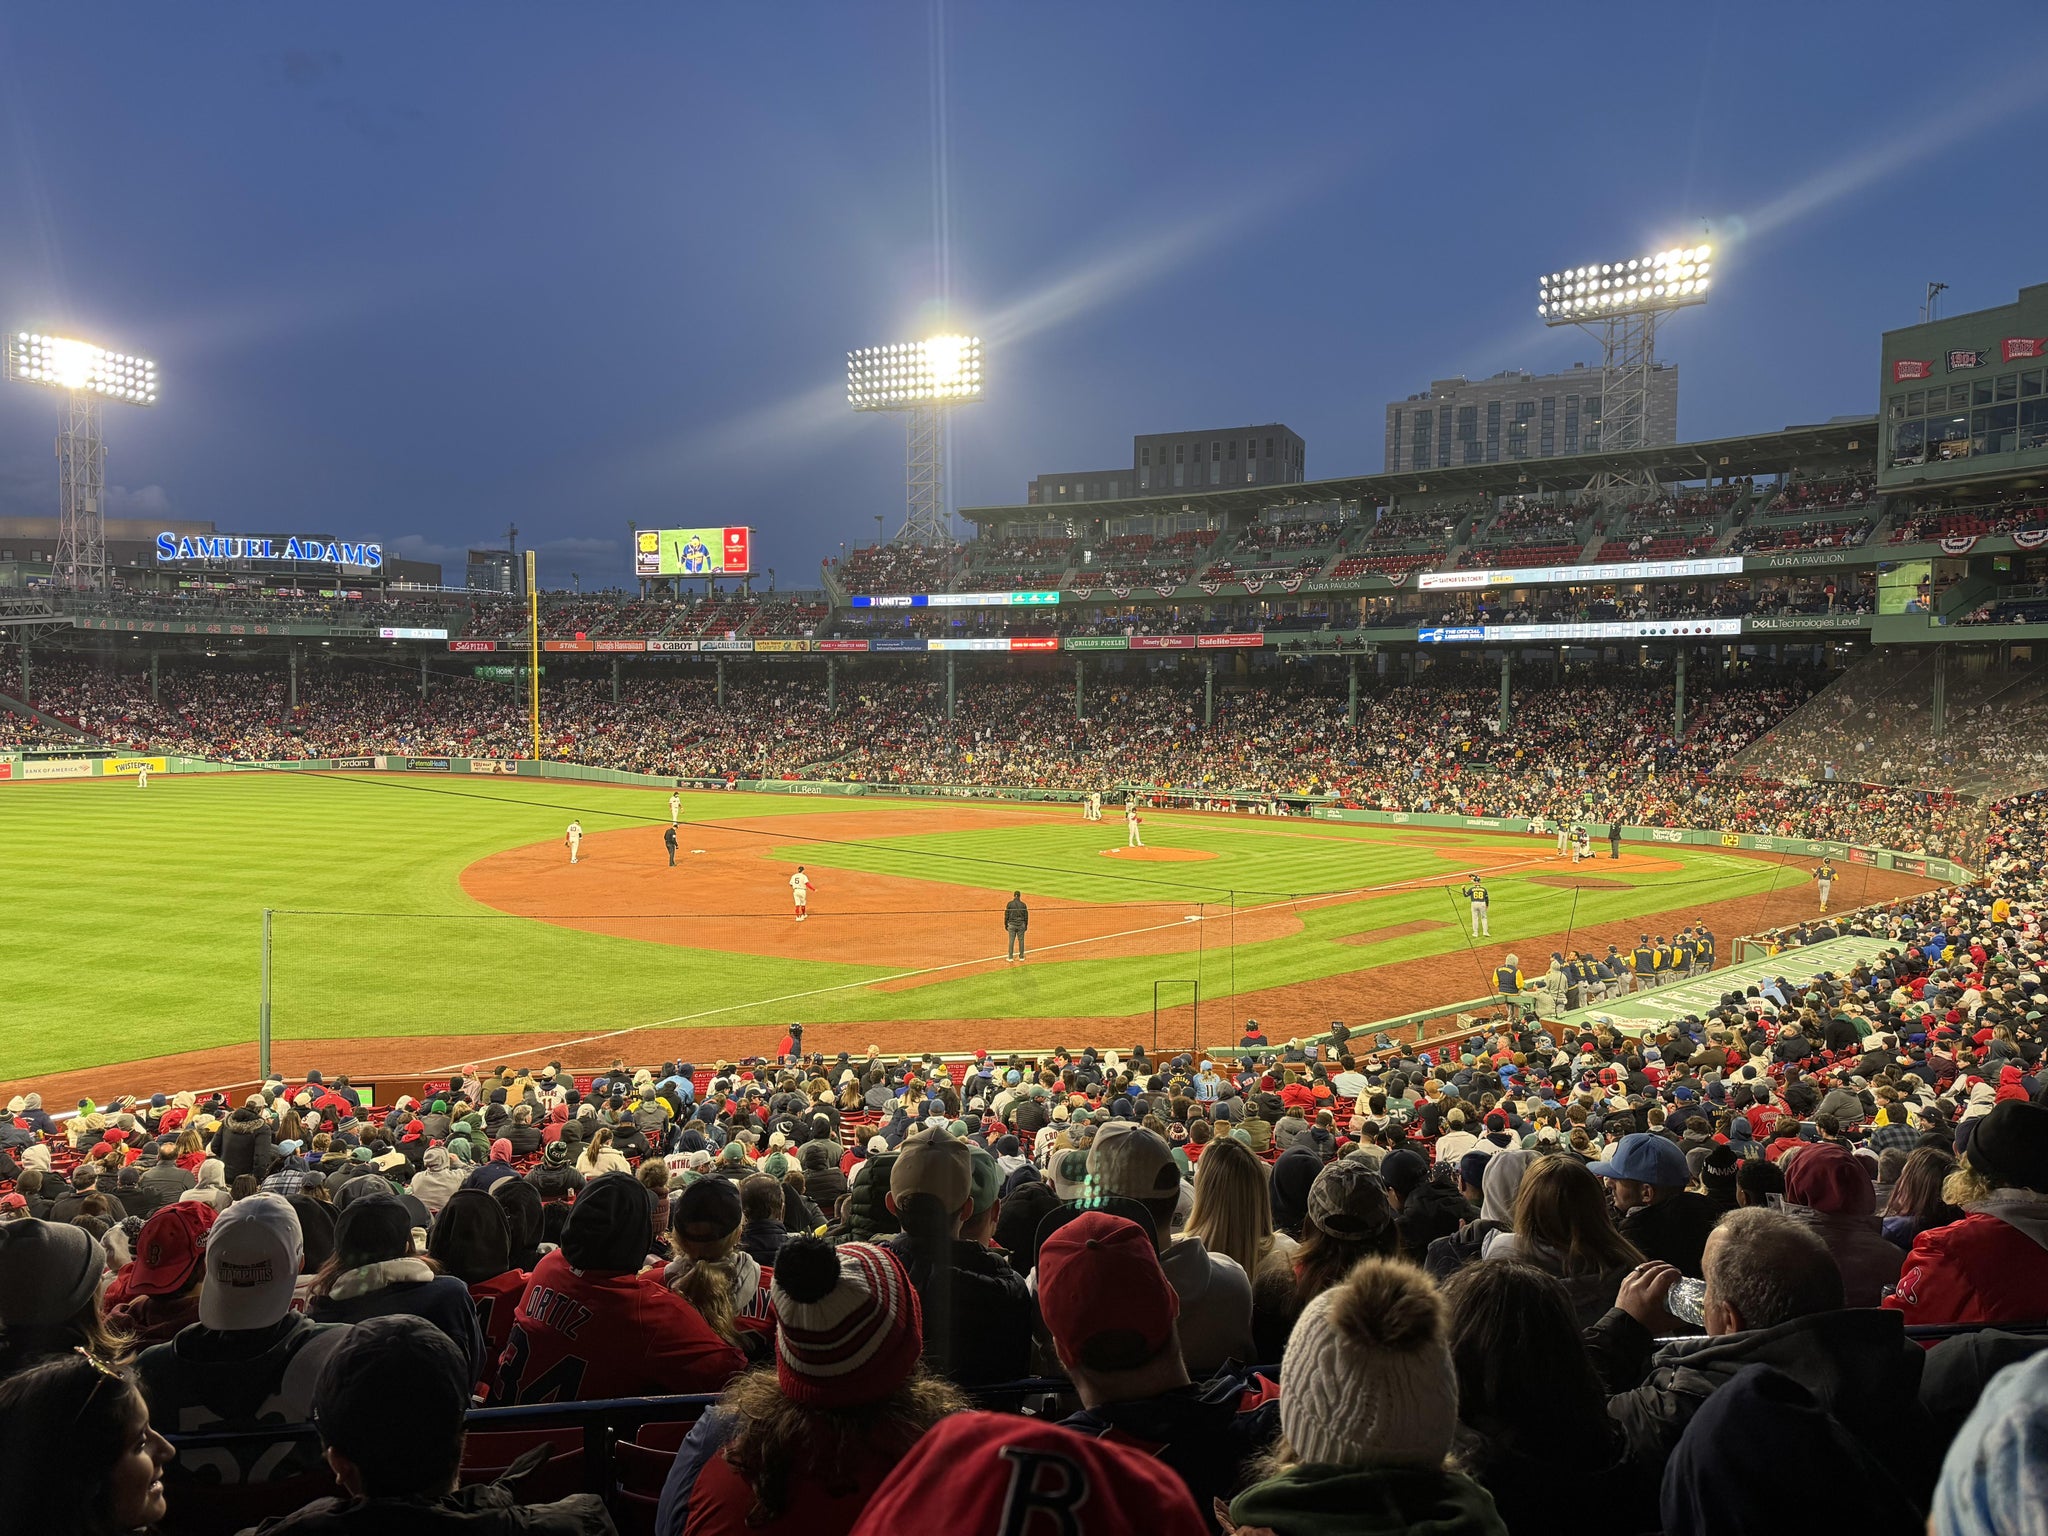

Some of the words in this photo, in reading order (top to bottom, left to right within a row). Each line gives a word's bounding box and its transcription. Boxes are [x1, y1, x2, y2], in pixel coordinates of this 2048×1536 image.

[156, 532, 278, 561] SAMUEL
[281, 536, 382, 568] ADAMS
[1802, 554, 1844, 565] PAVILION
[1331, 581, 1359, 589] PAVILION
[1778, 619, 1835, 629] Technologies
[1837, 617, 1860, 626] Level
[615, 642, 643, 650] Hawaiian
[1101, 639, 1125, 647] PICKLES
[1200, 638, 1229, 646] Safelite
[115, 762, 141, 773] TWISTED
[789, 785, 822, 795] L.L.Bean
[1823, 869, 1829, 877] 5
[794, 877, 800, 885] 5
[1473, 891, 1484, 900] 68
[1205, 1084, 1214, 1098] 11
[541, 1098, 553, 1111] 11
[1390, 1108, 1408, 1124] 25
[669, 1159, 690, 1171] ANTHO
[526, 1285, 593, 1341] ORTIZ
